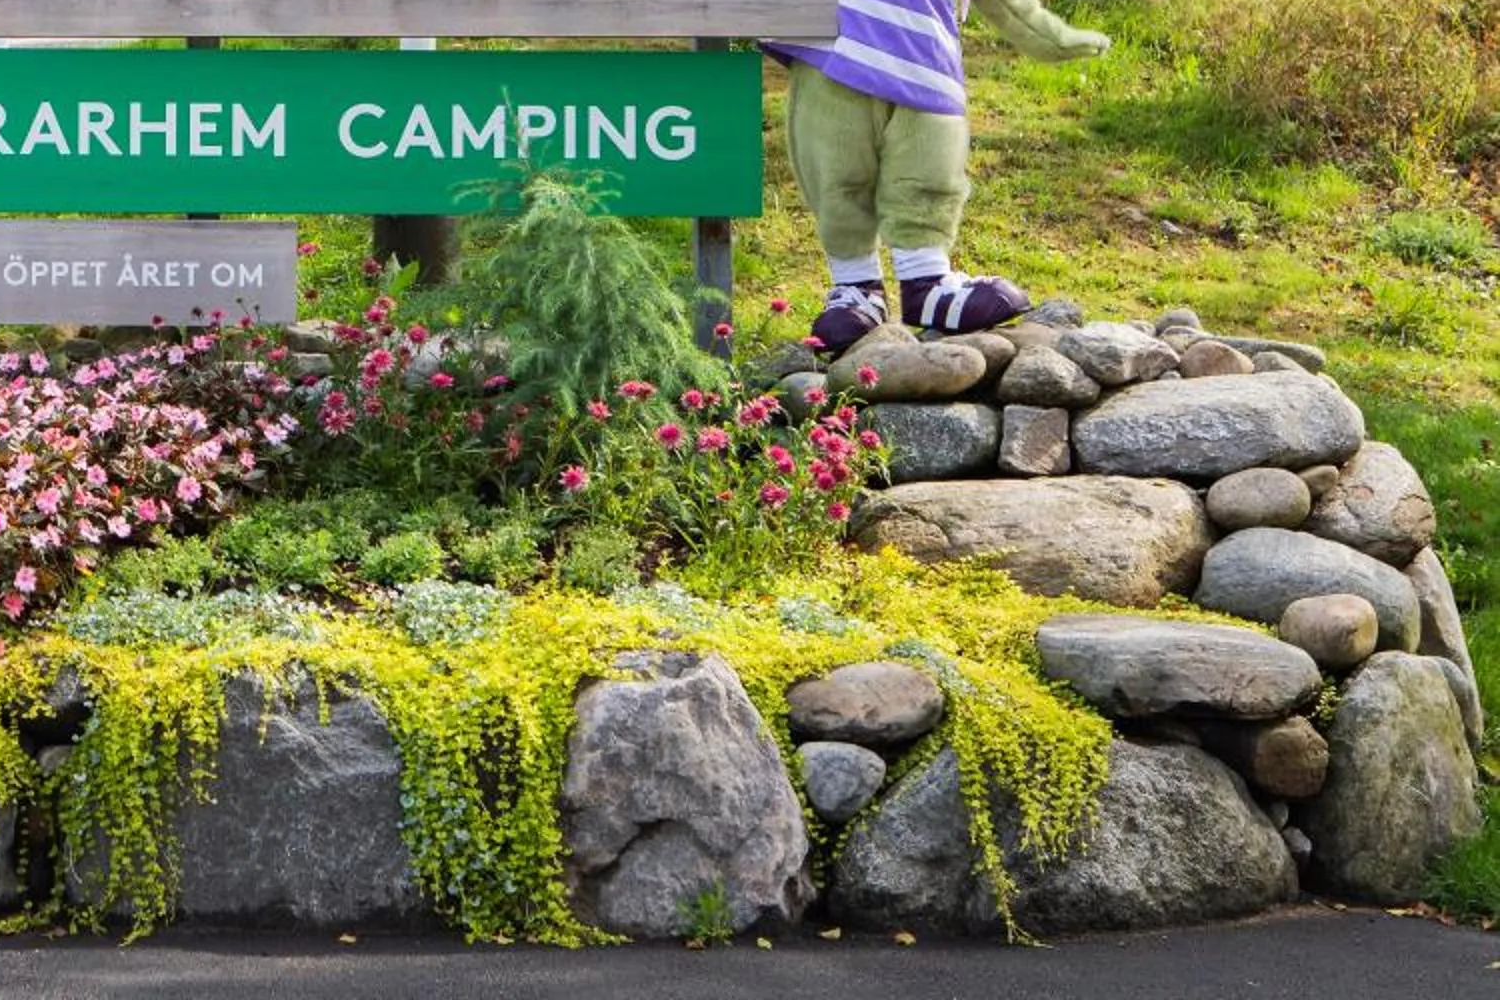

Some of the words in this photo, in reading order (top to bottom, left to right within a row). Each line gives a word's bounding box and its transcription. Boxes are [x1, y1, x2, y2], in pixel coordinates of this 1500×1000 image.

[337, 102, 697, 162] CAMPING
[2, 253, 107, 288] ÖPPET
[116, 253, 198, 288] ÅRET
[209, 262, 264, 288] OM
